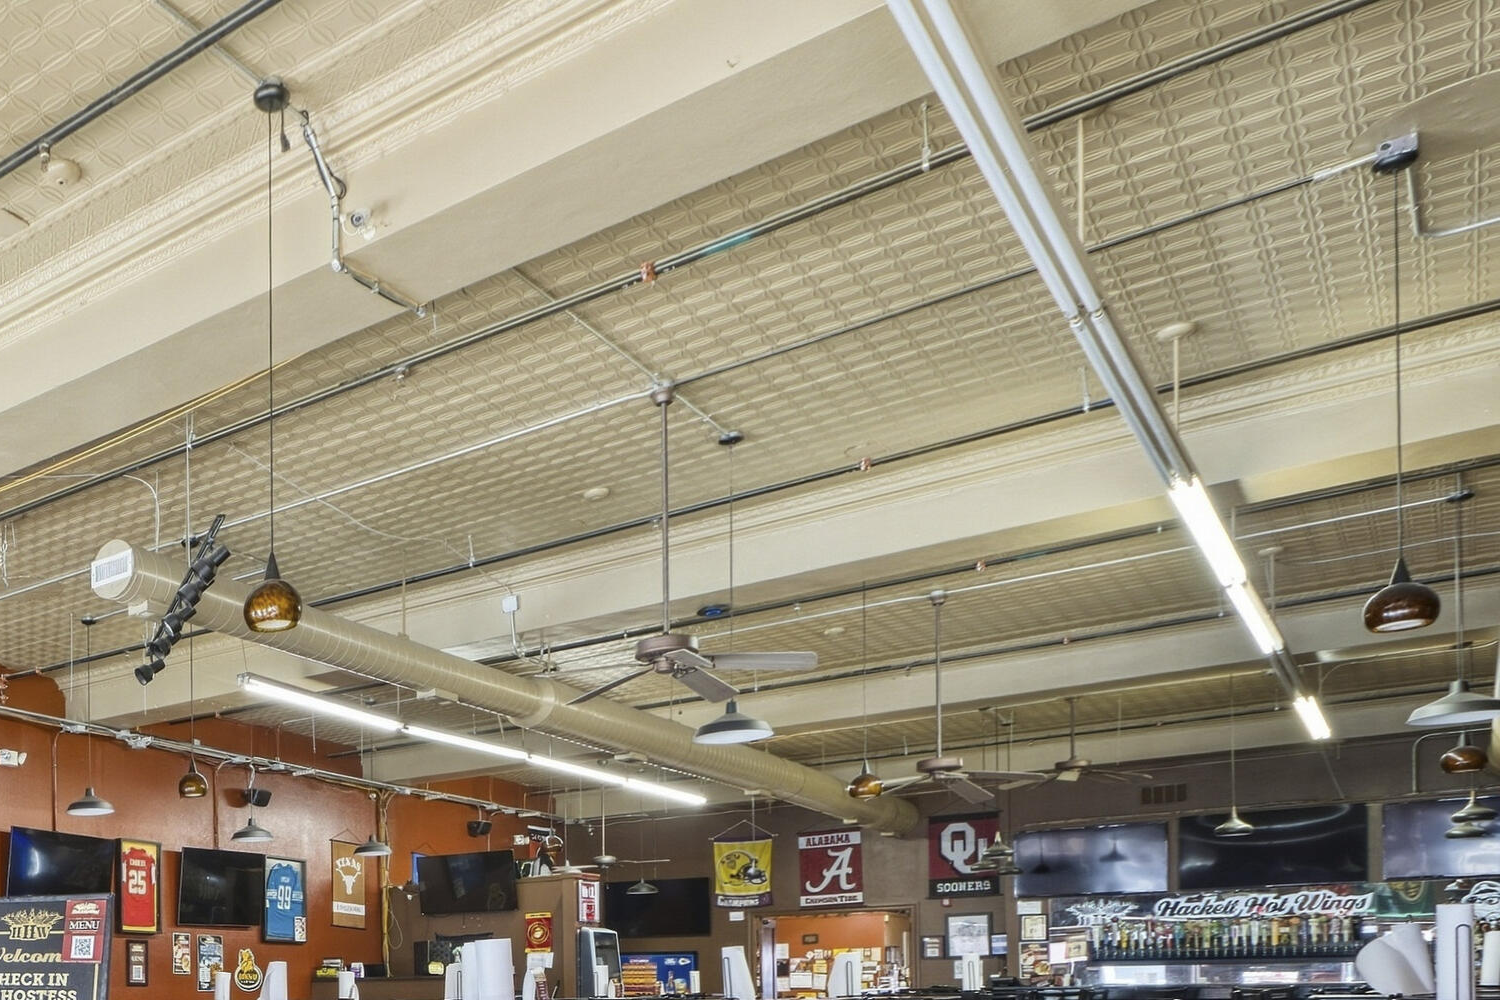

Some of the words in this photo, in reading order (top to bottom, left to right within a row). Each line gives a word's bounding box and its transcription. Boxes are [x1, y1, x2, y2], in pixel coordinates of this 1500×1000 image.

[805, 833, 851, 847] ALABAMA
[336, 856, 362, 873] TEXAS
[128, 869, 148, 895] 25
[936, 880, 991, 893] SOONERS
[277, 885, 292, 910] 99
[1243, 895, 1289, 916] Hot
[1294, 892, 1369, 915] Wings
[69, 920, 100, 930] MENU
[48, 973, 69, 987] IN
